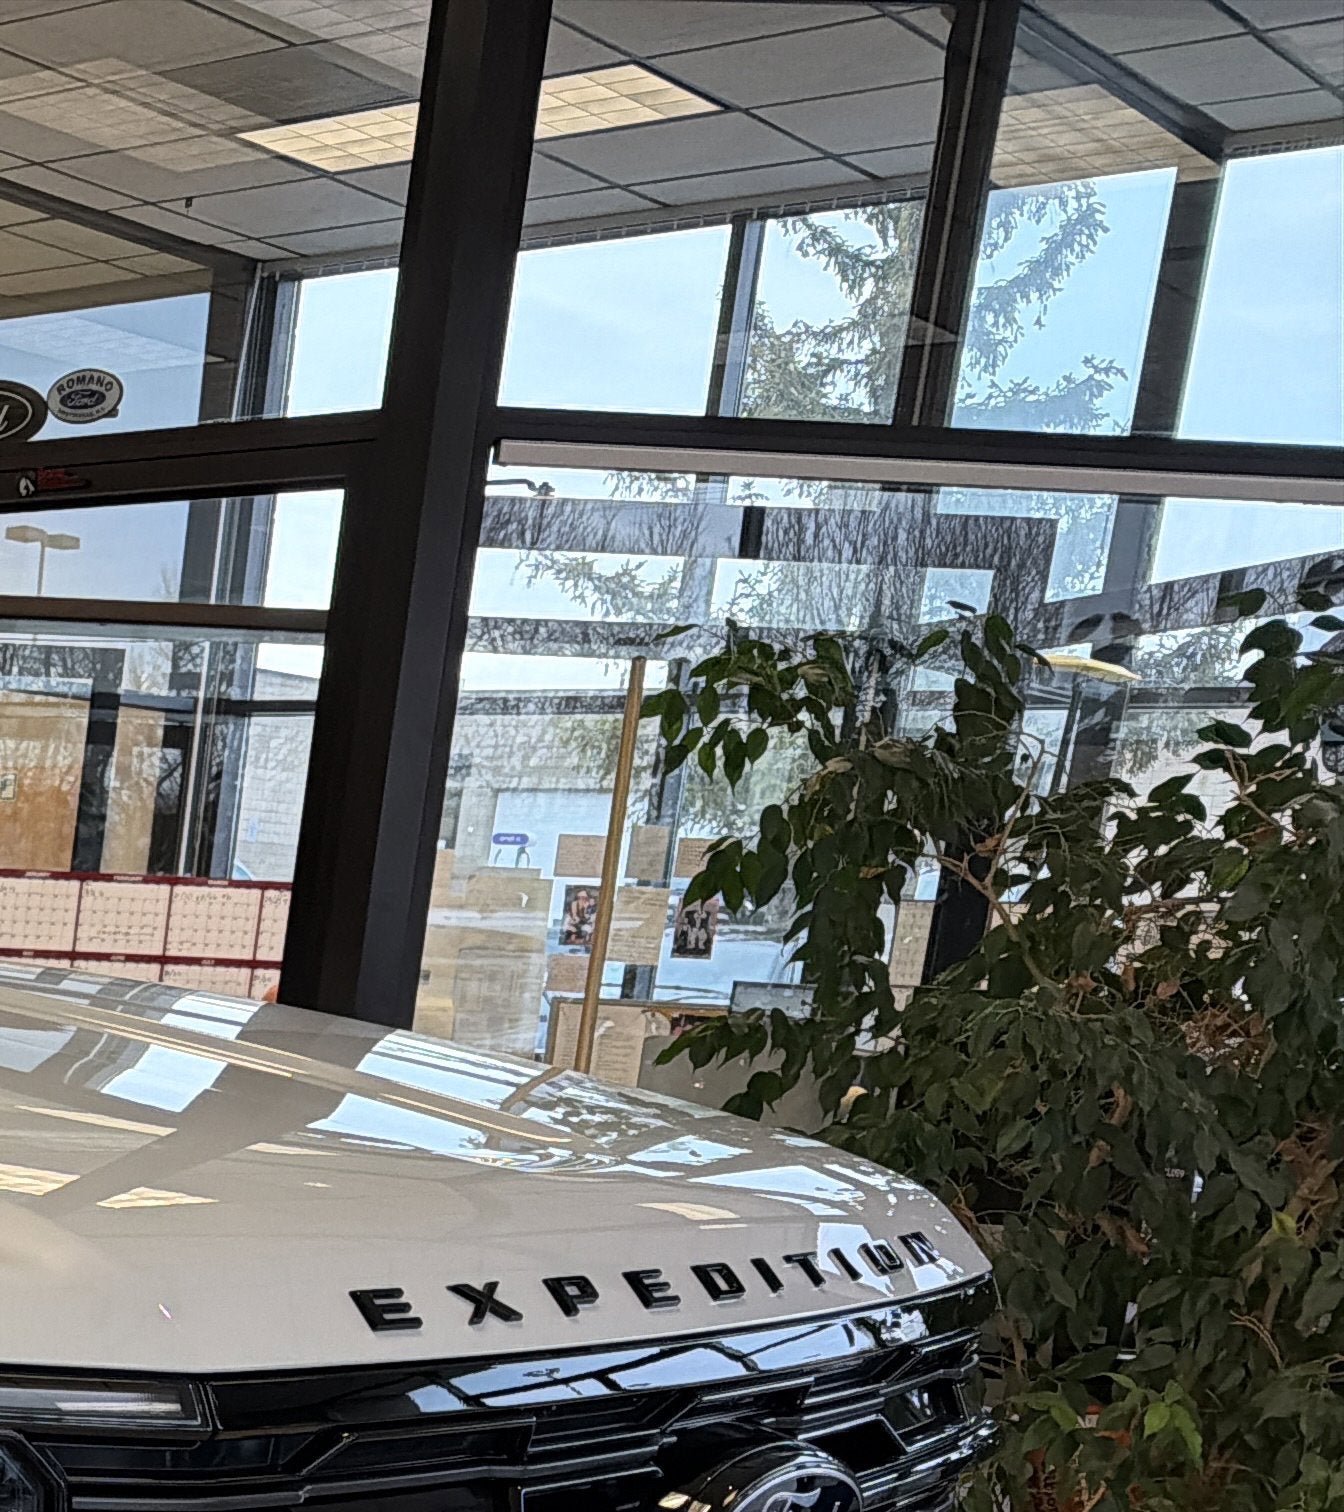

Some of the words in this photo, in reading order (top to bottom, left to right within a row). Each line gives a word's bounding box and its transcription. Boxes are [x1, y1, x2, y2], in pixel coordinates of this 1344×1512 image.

[56, 373, 114, 396] ROMANO
[66, 390, 98, 407] Ford
[349, 1230, 940, 1332] EXPEDITION
